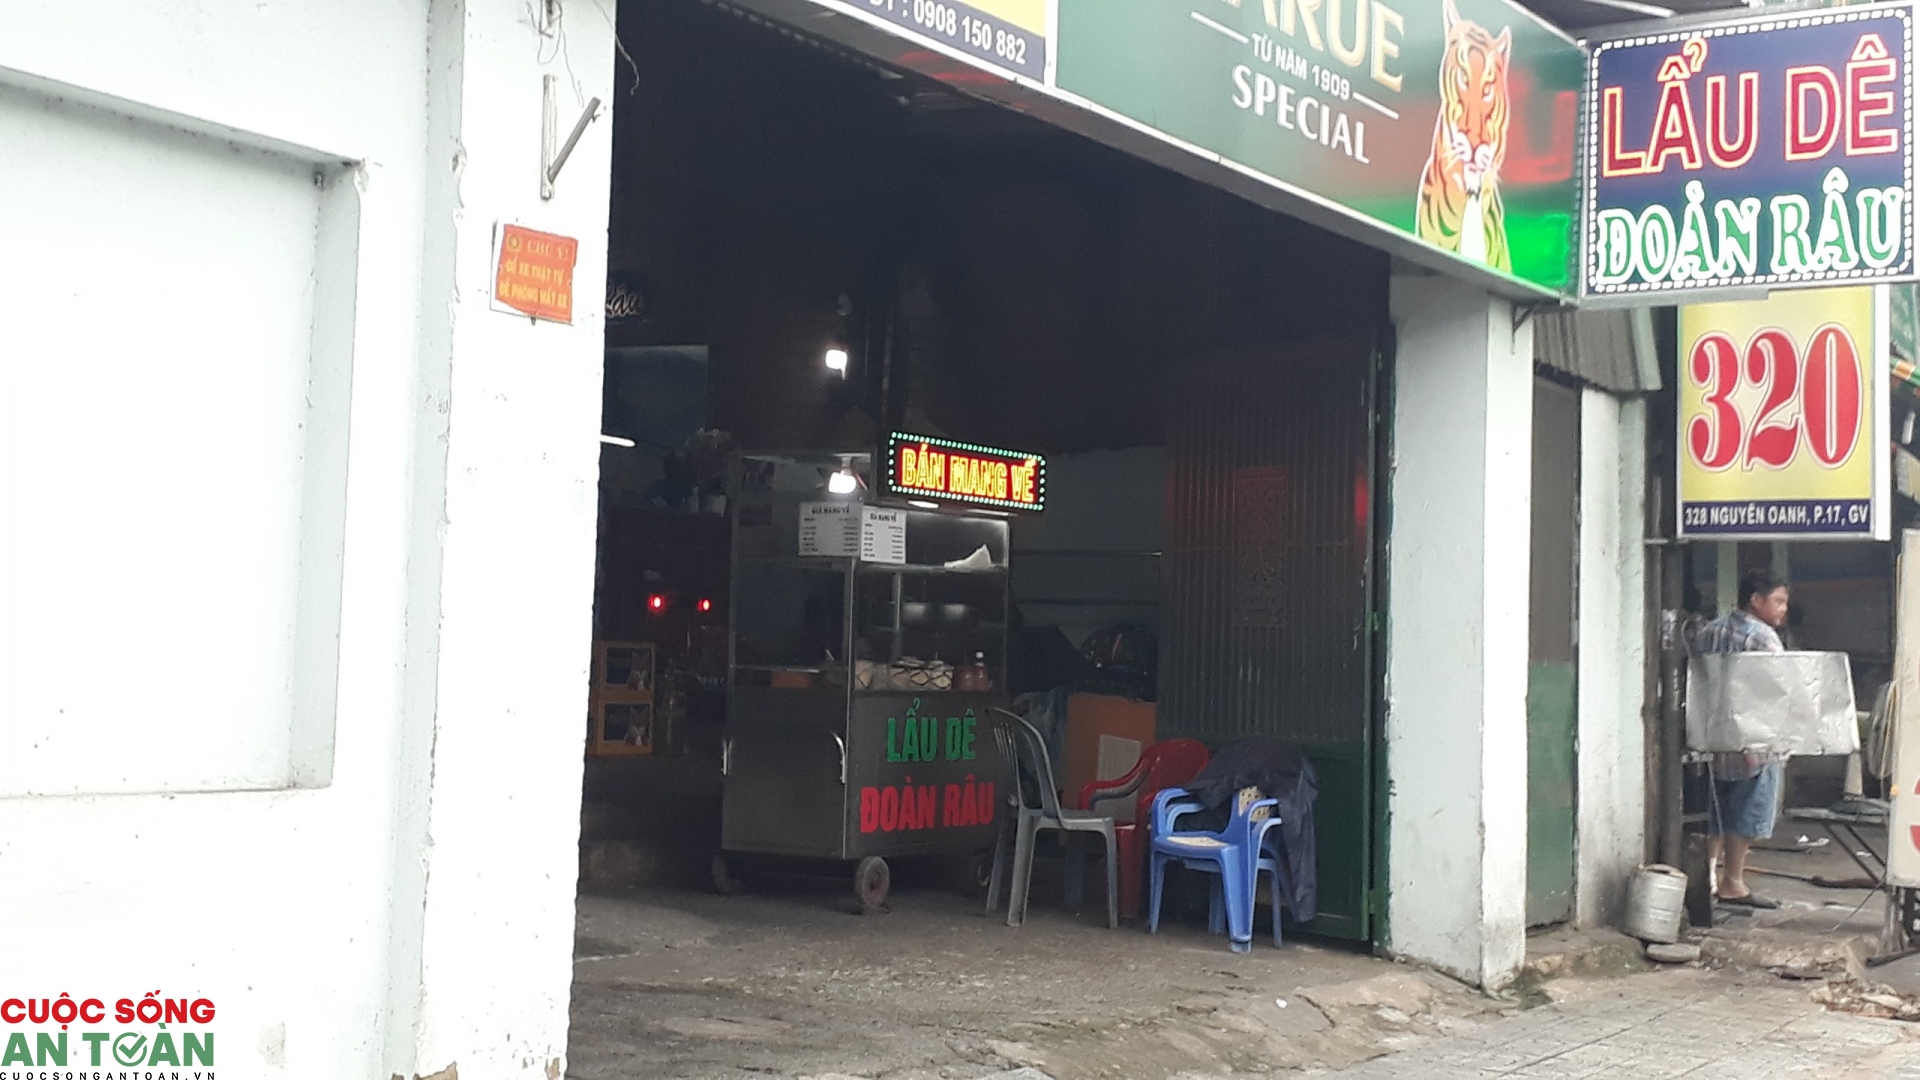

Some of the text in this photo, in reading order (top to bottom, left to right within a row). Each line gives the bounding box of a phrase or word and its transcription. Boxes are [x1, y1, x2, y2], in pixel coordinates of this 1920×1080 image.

[914, 0, 957, 37] 0908
[962, 16, 992, 51] 150
[996, 29, 1027, 65] 882
[1275, 44, 1308, 81] NĂM
[1311, 64, 1350, 101] 1909
[1232, 64, 1371, 165] SPECIAL
[1602, 33, 1899, 179] LẨU DÊ
[1769, 166, 1904, 275] RÂU
[1686, 321, 1865, 472] 320
[902, 443, 946, 489] BÁN
[949, 455, 1008, 499] MANG
[1685, 506, 1707, 526] 328
[1768, 505, 1811, 526] OANH,
[1814, 505, 1845, 526] P.17,
[1848, 505, 1869, 524] GV
[887, 697, 976, 763] LẨU DÊ
[859, 774, 995, 834] ĐOÀN RÂU
